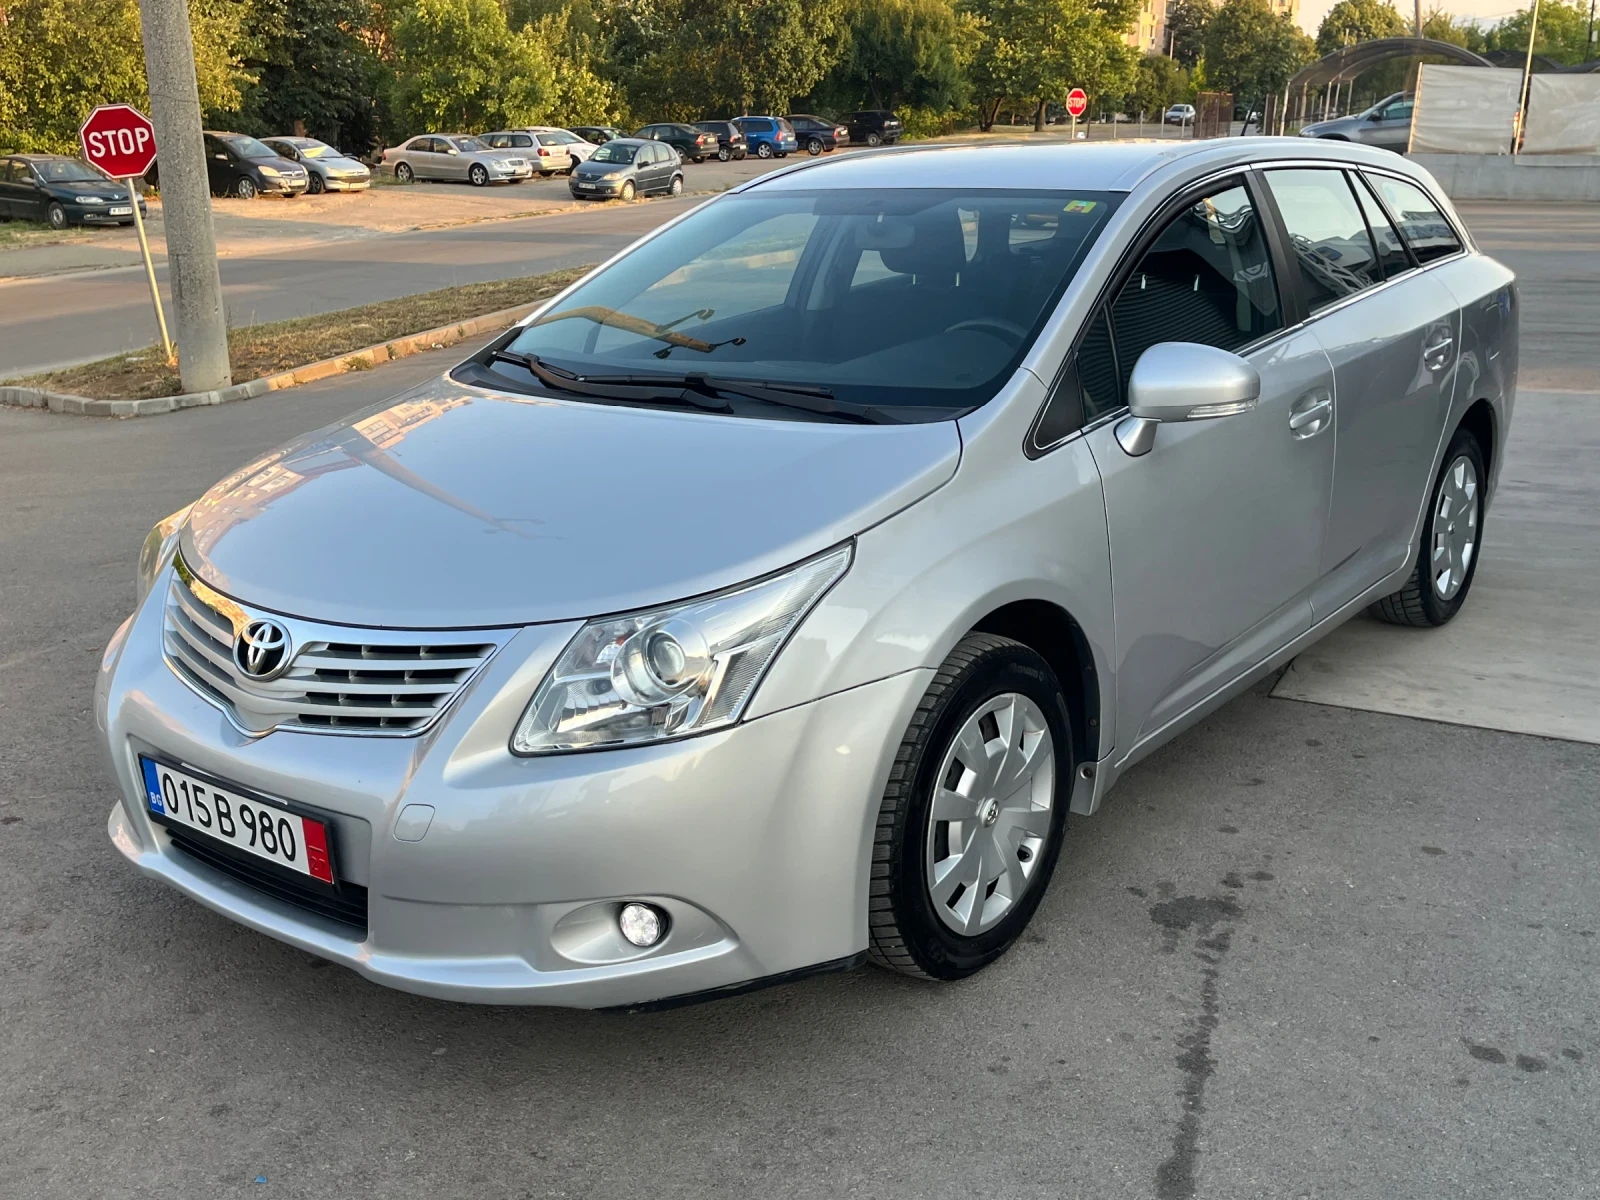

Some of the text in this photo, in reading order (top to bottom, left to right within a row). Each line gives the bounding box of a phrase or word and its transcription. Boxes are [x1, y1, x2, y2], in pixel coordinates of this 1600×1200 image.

[1068, 97, 1085, 108] STOP
[88, 127, 150, 158] STOP
[150, 791, 163, 806] BG
